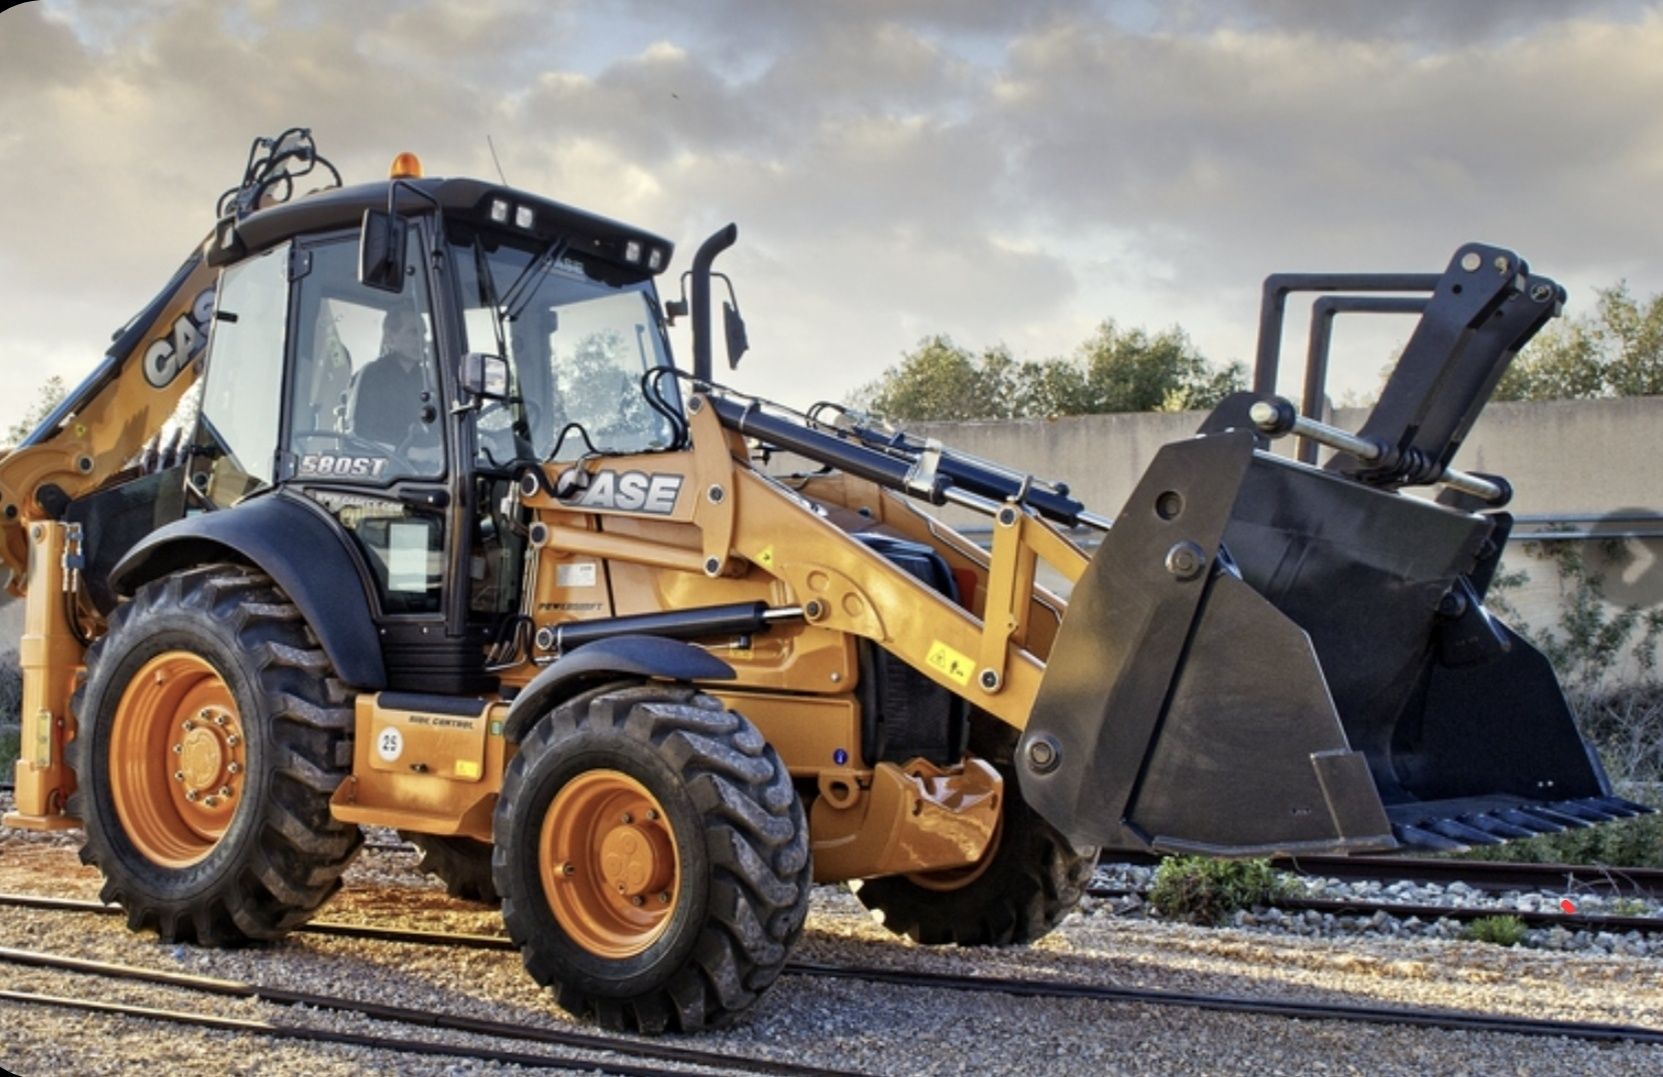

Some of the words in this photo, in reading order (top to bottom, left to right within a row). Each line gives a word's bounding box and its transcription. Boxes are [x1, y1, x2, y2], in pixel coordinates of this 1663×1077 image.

[142, 288, 214, 388] CAS
[302, 455, 389, 477] 580ST
[556, 467, 684, 515] CASE
[432, 718, 474, 729] CONTROL
